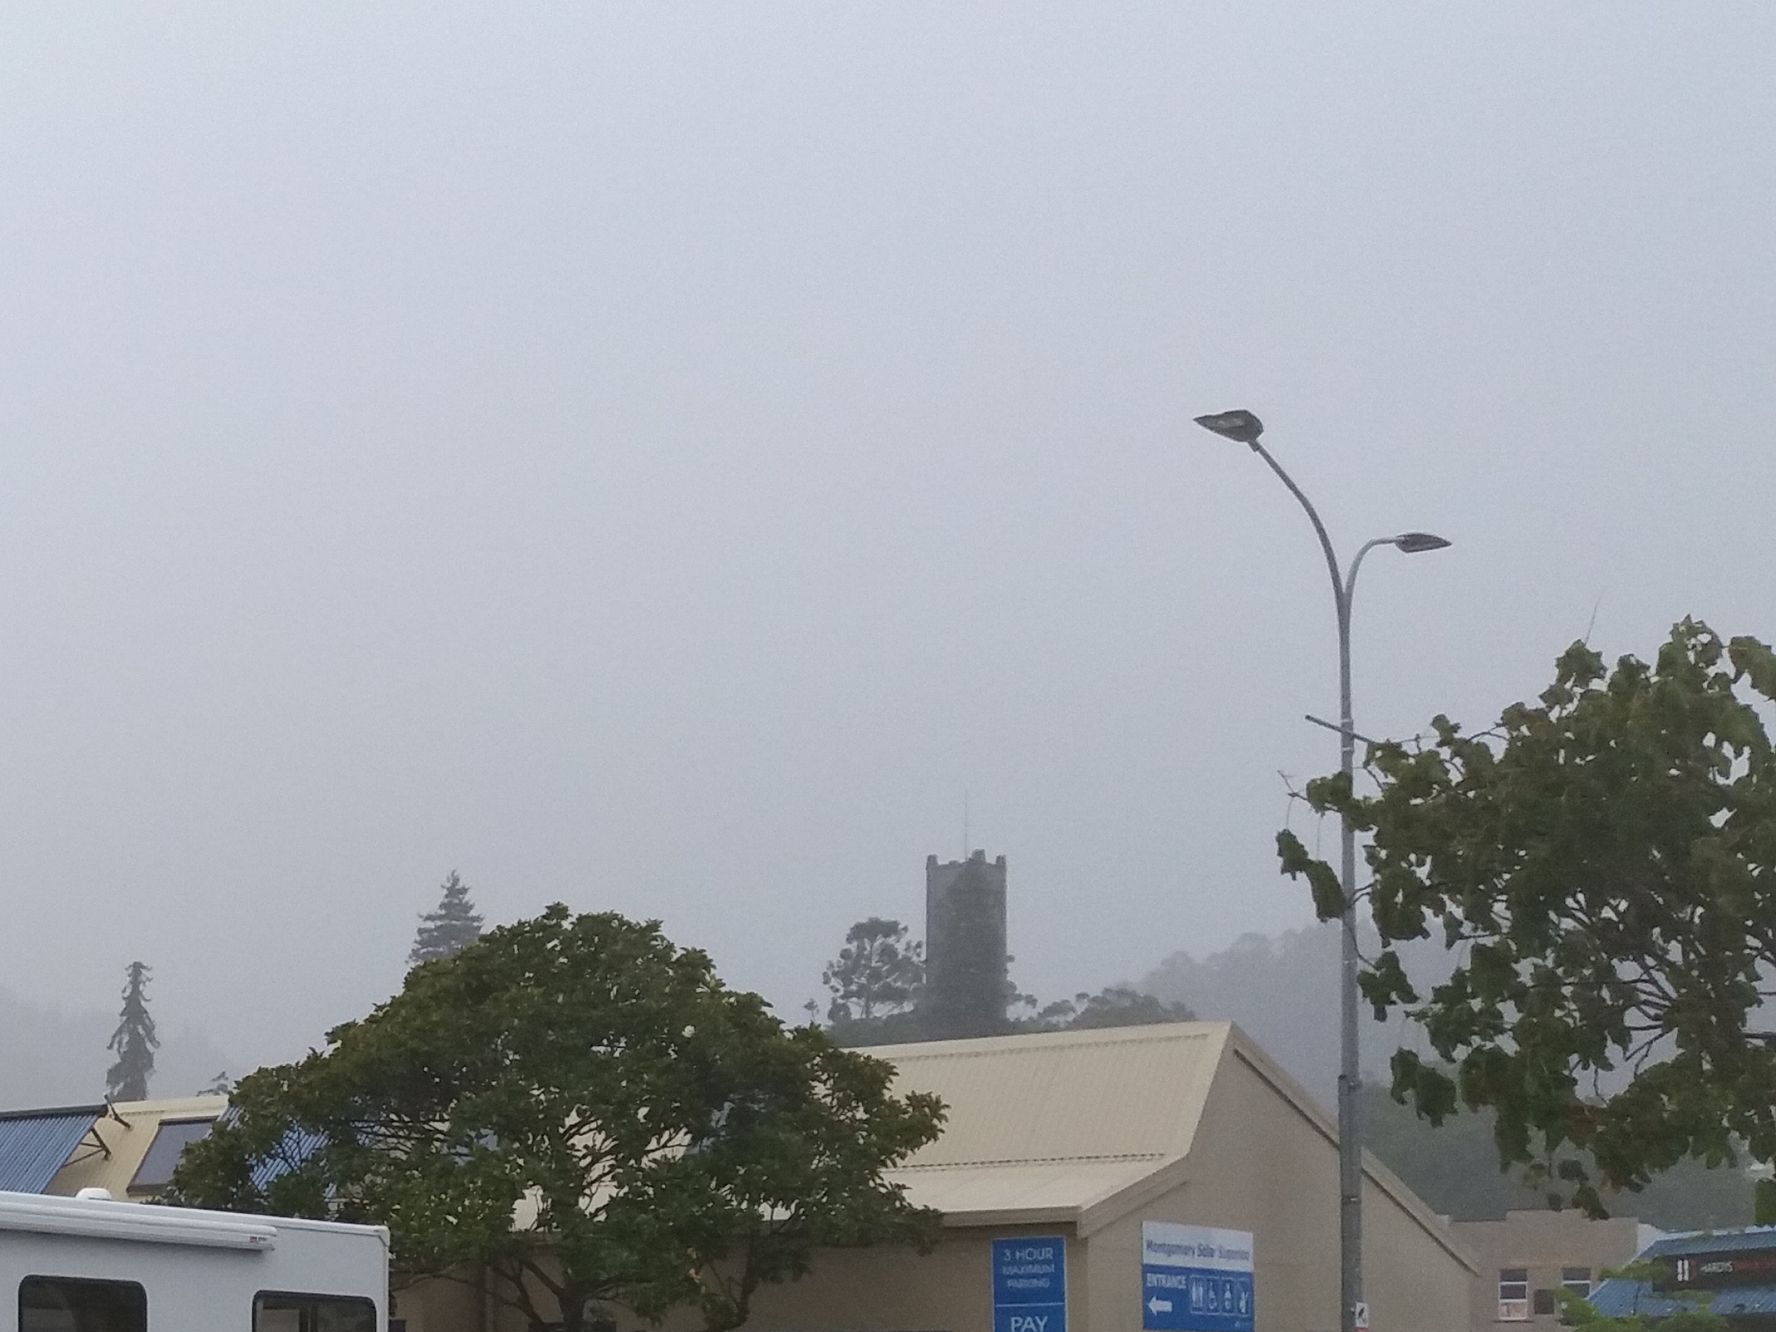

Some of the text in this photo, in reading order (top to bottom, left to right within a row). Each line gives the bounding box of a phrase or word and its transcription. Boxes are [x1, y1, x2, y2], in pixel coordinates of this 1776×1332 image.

[1003, 1247, 1053, 1261] 3 HOUR
[1002, 1263, 1055, 1275] MAXIMUM
[1146, 1272, 1186, 1289] ENTRANCE
[1010, 1316, 1049, 1332] PAY
